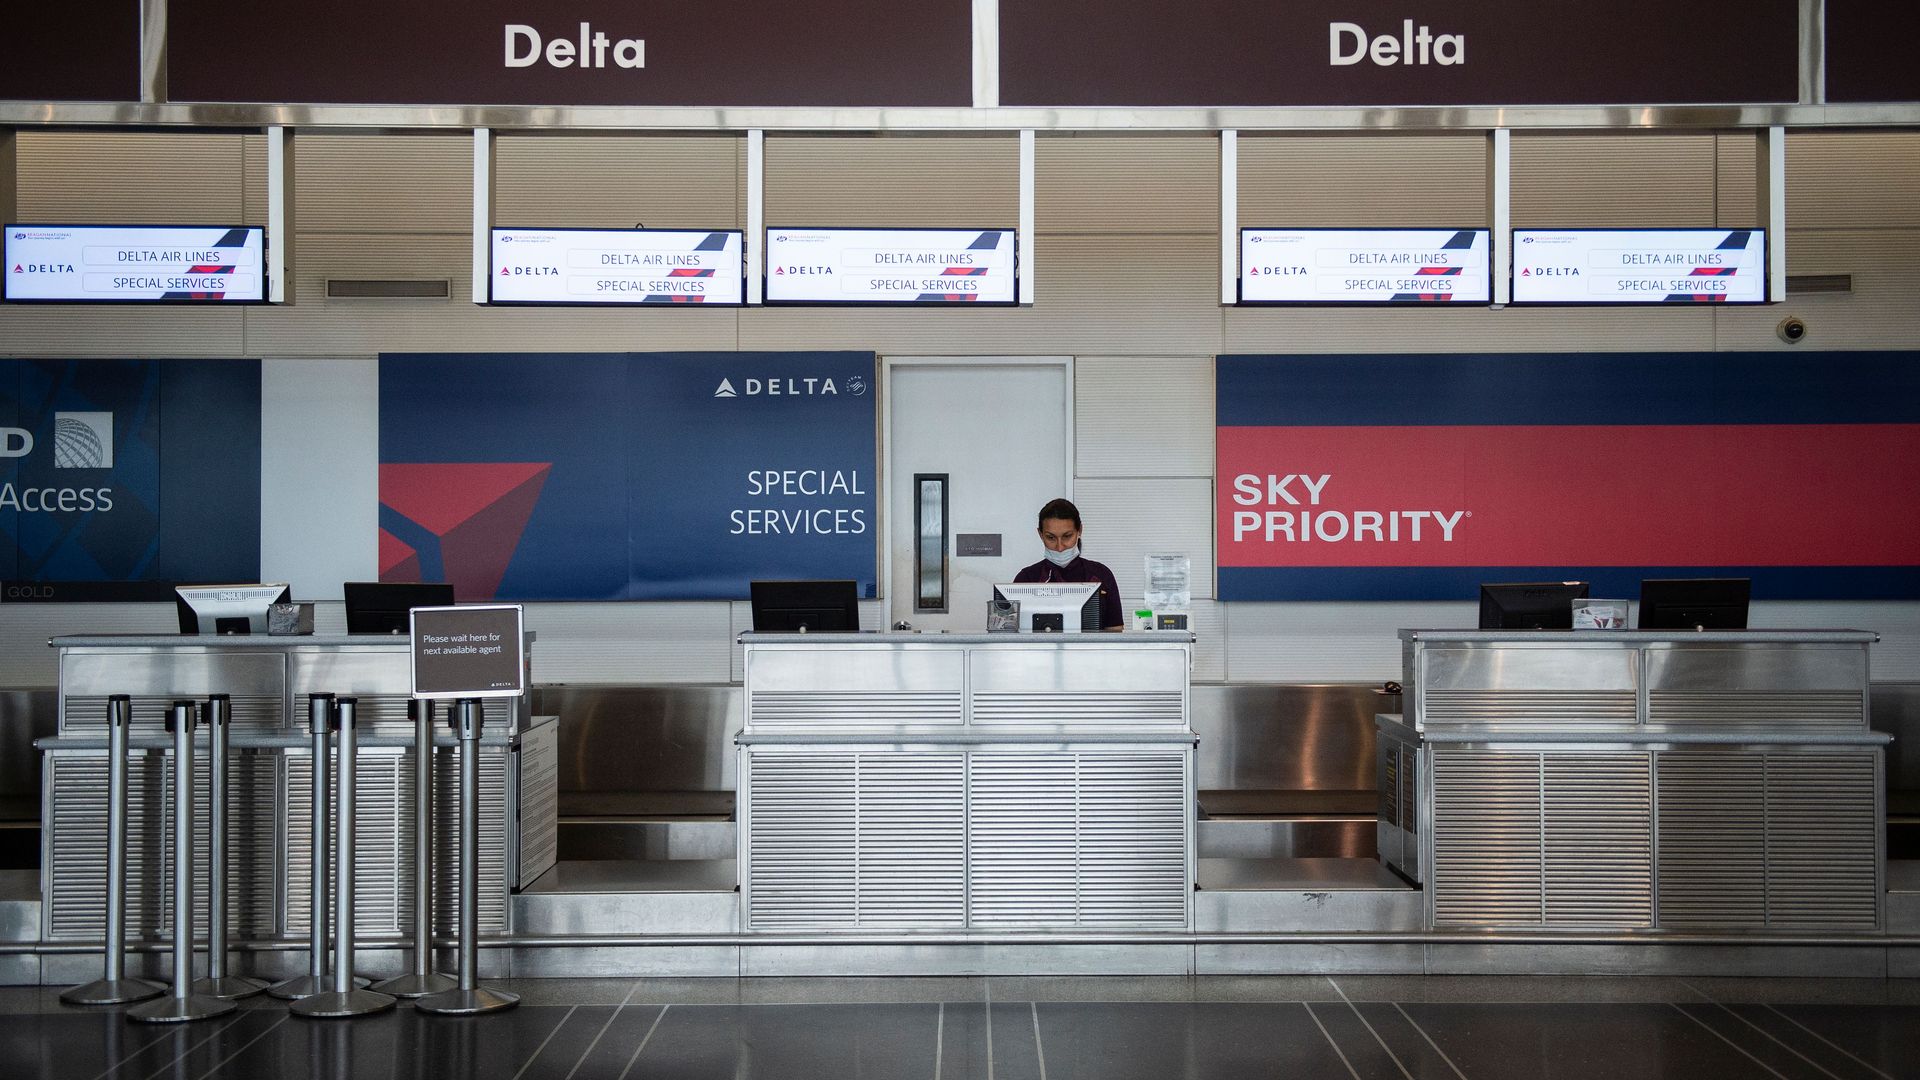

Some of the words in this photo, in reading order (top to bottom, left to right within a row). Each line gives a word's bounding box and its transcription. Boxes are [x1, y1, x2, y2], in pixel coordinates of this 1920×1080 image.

[504, 22, 645, 69] Delta
[1329, 19, 1465, 67] Delta
[118, 251, 157, 262] DELTA
[161, 251, 181, 262] AIR
[185, 251, 220, 262] LINES
[601, 254, 640, 265] DELTA
[643, 254, 663, 265] AIR
[666, 255, 701, 266] LINES
[875, 253, 913, 264] DELTA
[916, 253, 936, 264] AIR
[939, 254, 974, 264] LINES
[1349, 253, 1388, 264] DELTA
[1390, 253, 1410, 264] AIR
[1414, 253, 1448, 264] LINES
[1622, 254, 1661, 265] DELTA
[1664, 254, 1684, 265] AIR
[1688, 254, 1722, 265] LINES
[28, 264, 74, 273] DELTA
[514, 266, 559, 275] DELTA
[789, 266, 833, 275] DELTA
[1264, 266, 1307, 275] DELTA
[1536, 267, 1580, 276] DELTA
[113, 278, 163, 289] SPECIAL
[167, 278, 225, 289] SERVICES
[596, 281, 645, 291] SPECIAL
[649, 281, 705, 292] SERVICES
[870, 280, 918, 290] SPECIAL
[922, 280, 978, 291] SERVICES
[1345, 280, 1392, 290] SPECIAL
[1396, 280, 1452, 290] SERVICES
[1617, 280, 1666, 291] SPECIAL
[1670, 280, 1727, 291] SERVICES
[746, 378, 838, 395] DELTA
[747, 470, 866, 496] SPECIAL
[1232, 474, 1332, 505] SKY
[0, 483, 113, 512] Access
[730, 509, 866, 535] SERVICES
[7, 586, 55, 597] GOLD
[423, 634, 449, 643] Please
[451, 633, 468, 642] wait
[469, 633, 488, 642] here
[489, 632, 501, 641] for
[423, 647, 441, 655] next
[443, 646, 477, 655] available
[479, 645, 502, 655] agent
